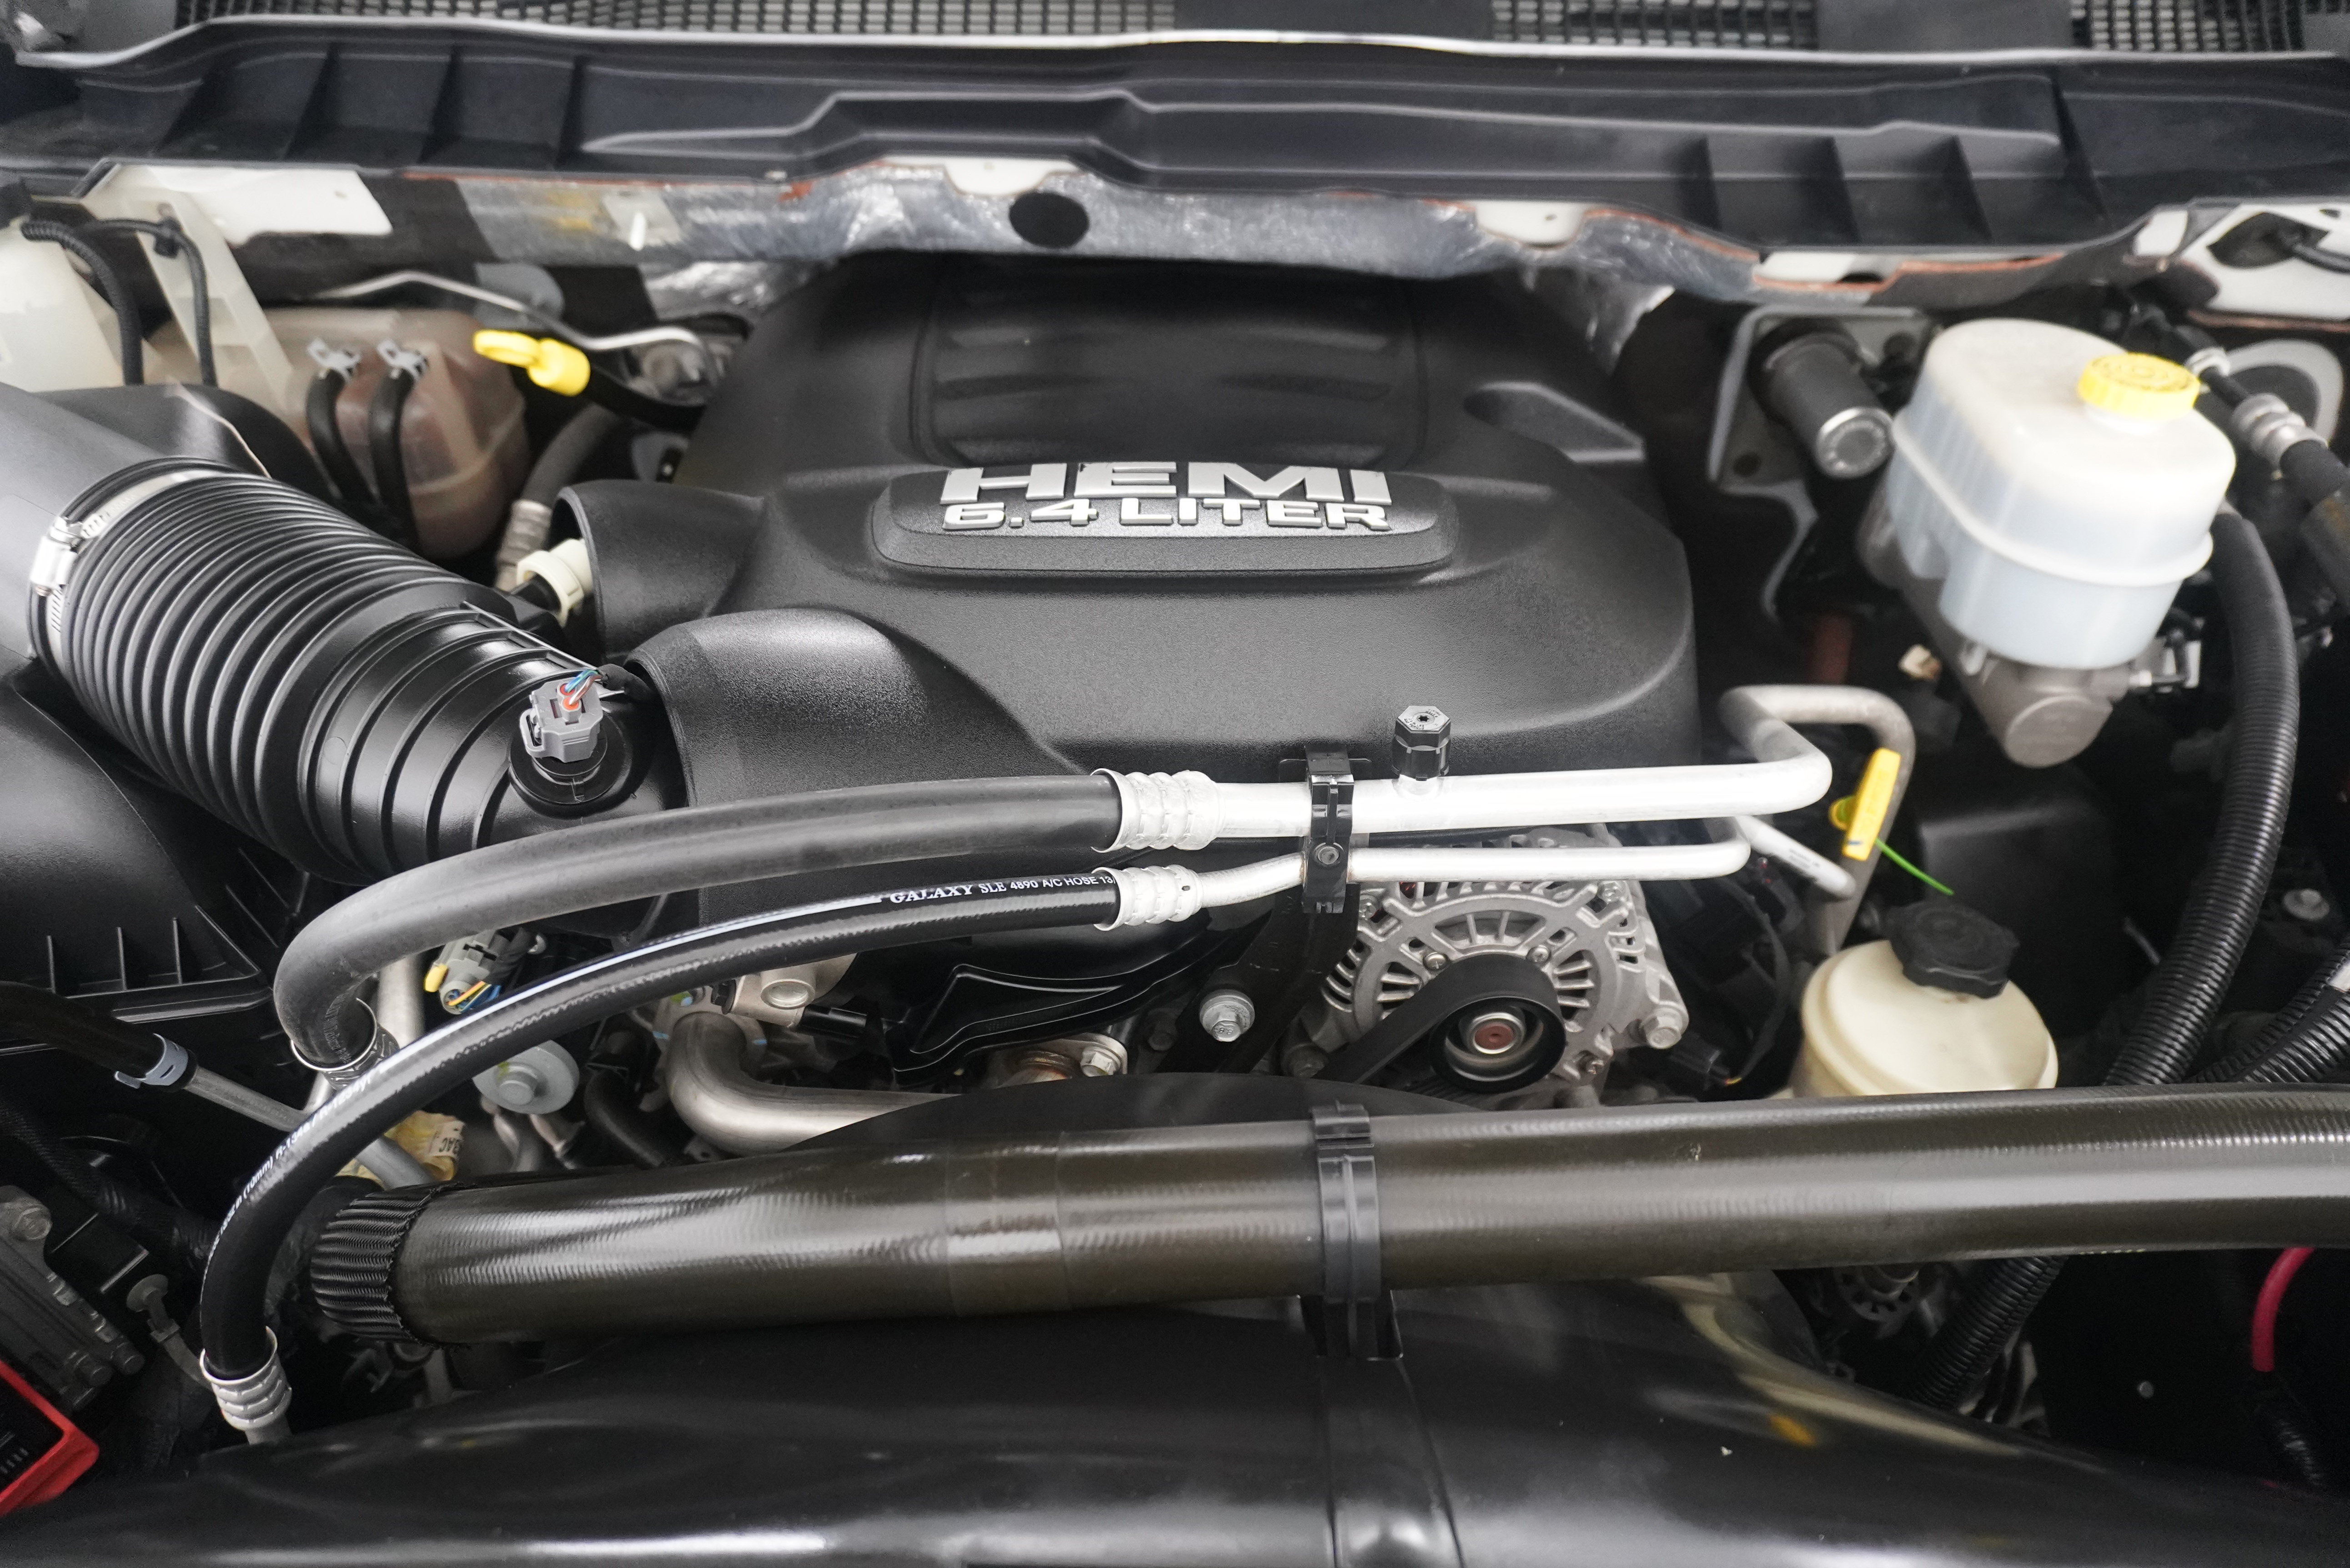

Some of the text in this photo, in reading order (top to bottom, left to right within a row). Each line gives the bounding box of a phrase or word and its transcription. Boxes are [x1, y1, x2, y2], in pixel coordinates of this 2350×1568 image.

[940, 461, 1391, 505] HEMI
[941, 498, 1391, 532] 6.4 LITER
[890, 885, 973, 903] GALAXY
[979, 881, 1006, 893] SLE
[1010, 880, 1038, 890] 4890
[1042, 879, 1062, 888] A/C
[1064, 876, 1099, 886] HOSE
[243, 1156, 273, 1199] (10mm)
